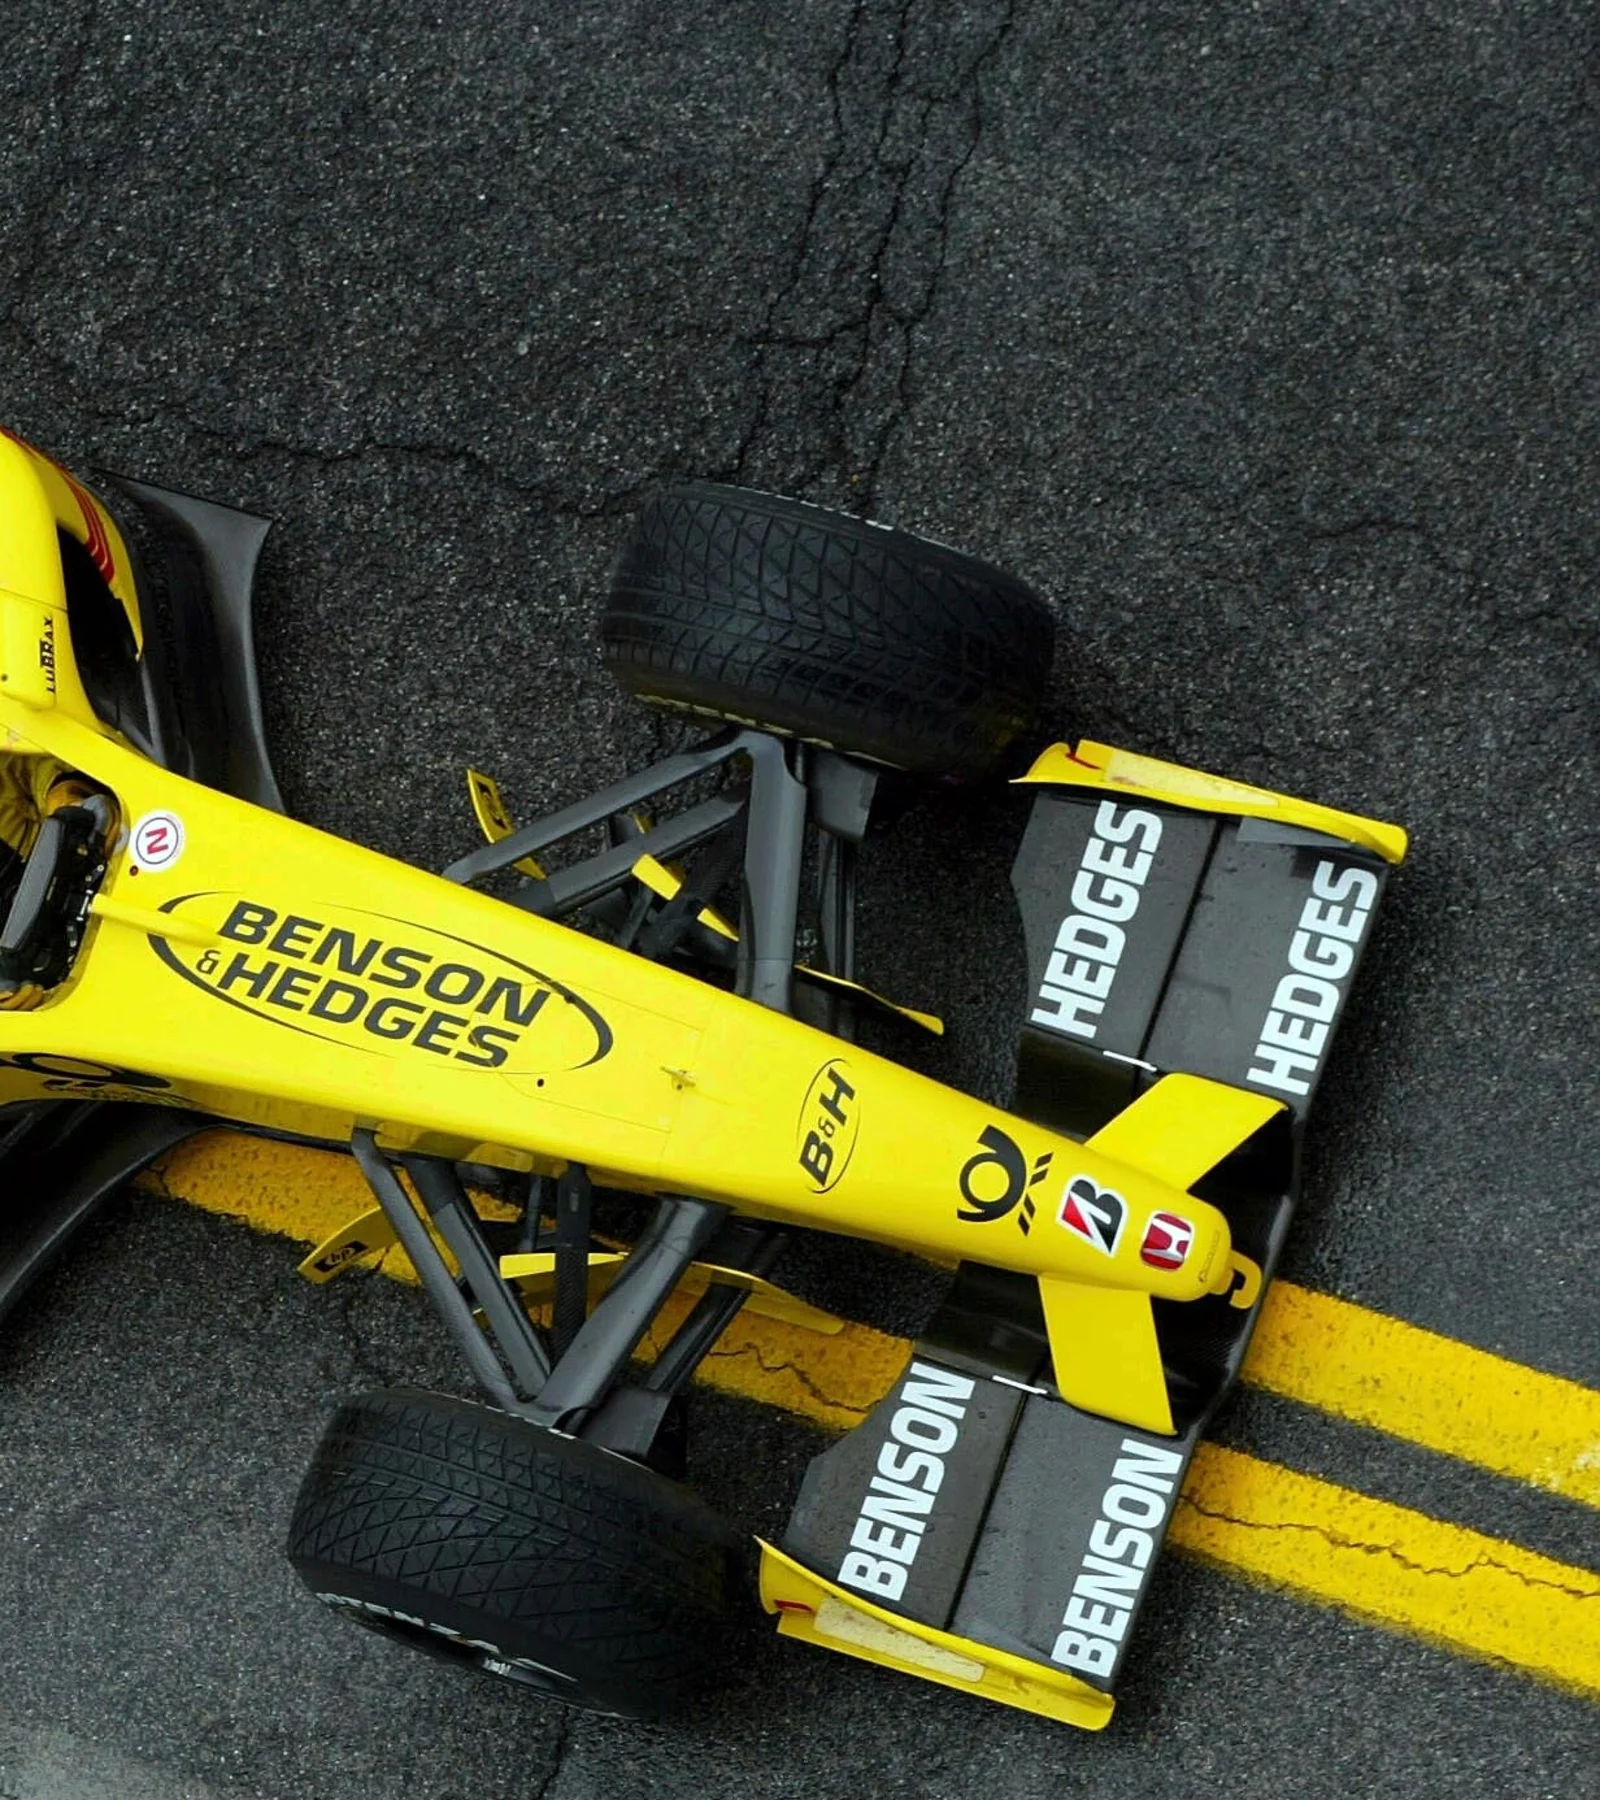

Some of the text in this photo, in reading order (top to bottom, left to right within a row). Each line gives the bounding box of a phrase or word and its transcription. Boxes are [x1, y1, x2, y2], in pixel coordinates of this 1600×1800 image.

[39, 617, 55, 694] LUBRAX
[145, 827, 169, 854] N
[217, 900, 551, 1027] BENSON
[1030, 800, 1163, 1039] HEDGES
[1247, 861, 1380, 1096] HEDGES
[196, 949, 520, 1068] & HEDGES
[799, 1067, 856, 1188] B&H
[837, 1362, 977, 1601] BENSON
[1051, 1439, 1184, 1677] BENSON
